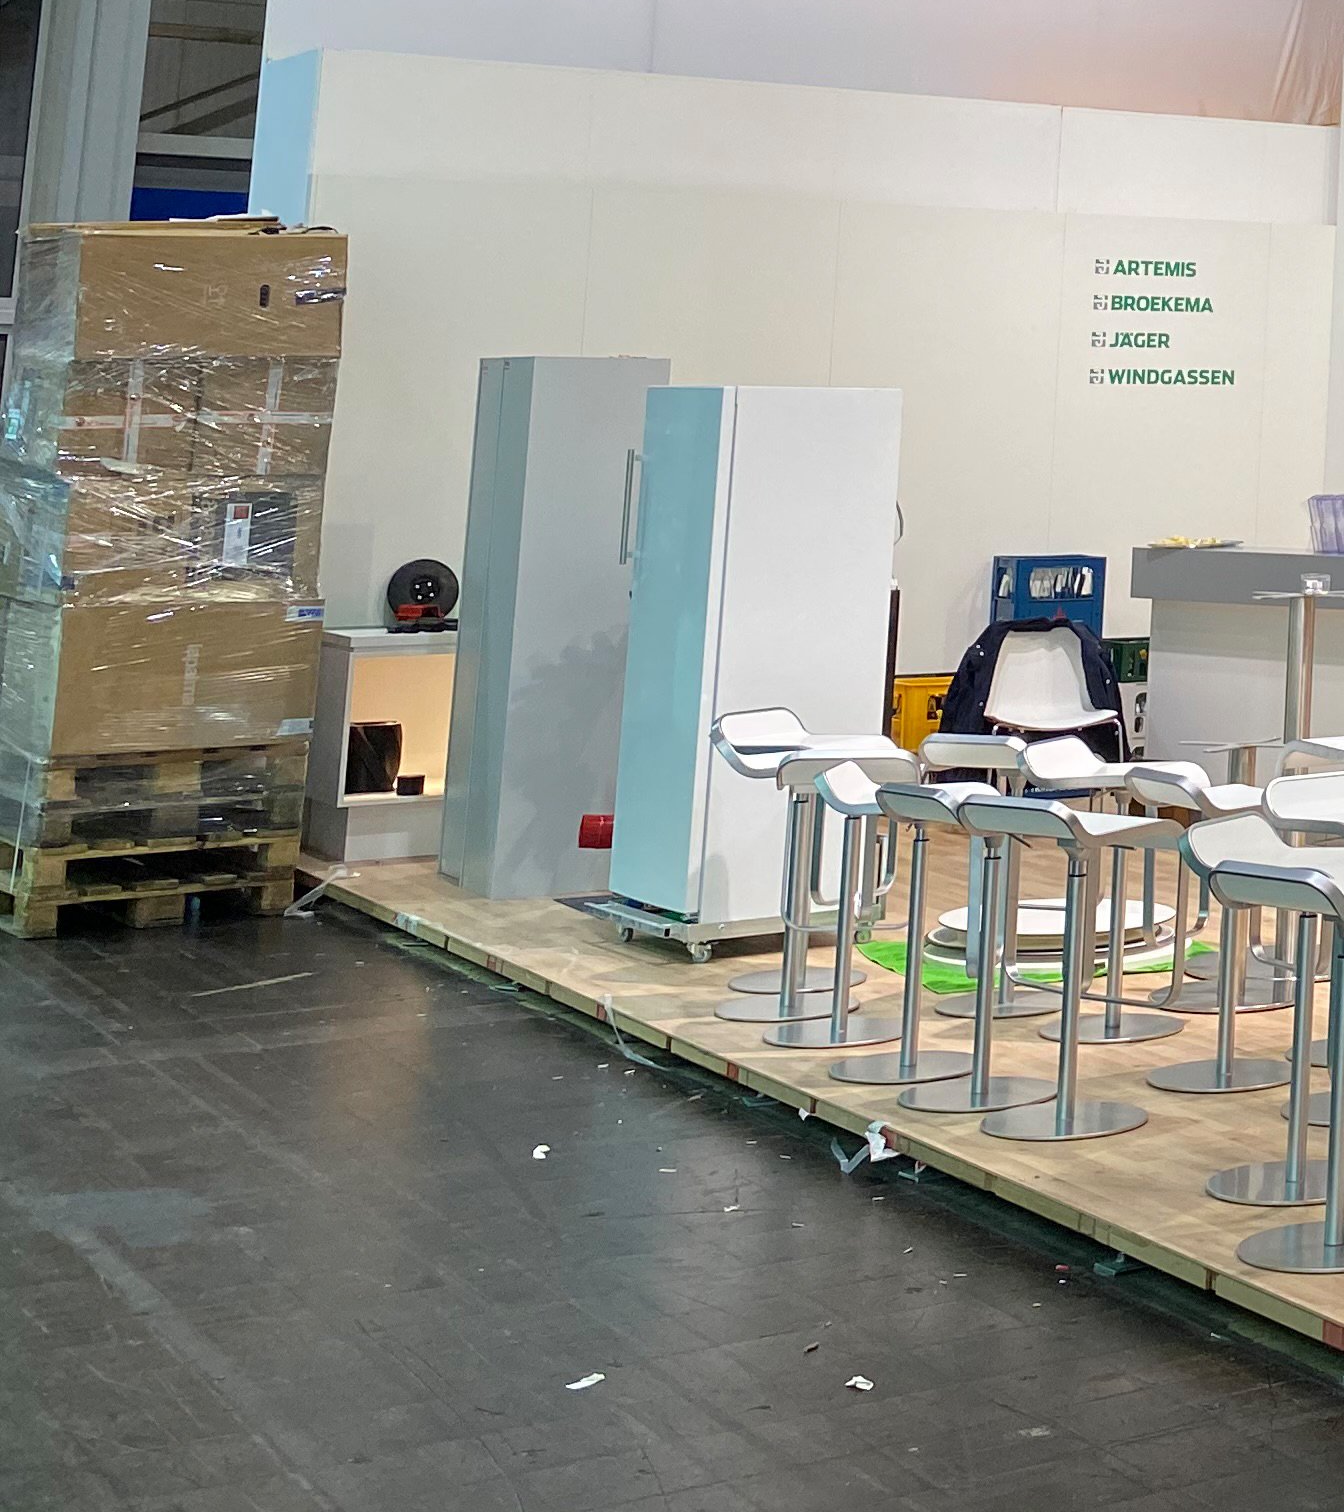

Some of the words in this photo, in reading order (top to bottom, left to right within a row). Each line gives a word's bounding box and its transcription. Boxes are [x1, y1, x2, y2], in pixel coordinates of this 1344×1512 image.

[1113, 259, 1197, 277] ARTEMIS
[1111, 295, 1214, 313] BROEKEMA
[1109, 331, 1170, 348] JÄGER
[1108, 369, 1236, 385] WINDGASSEN
